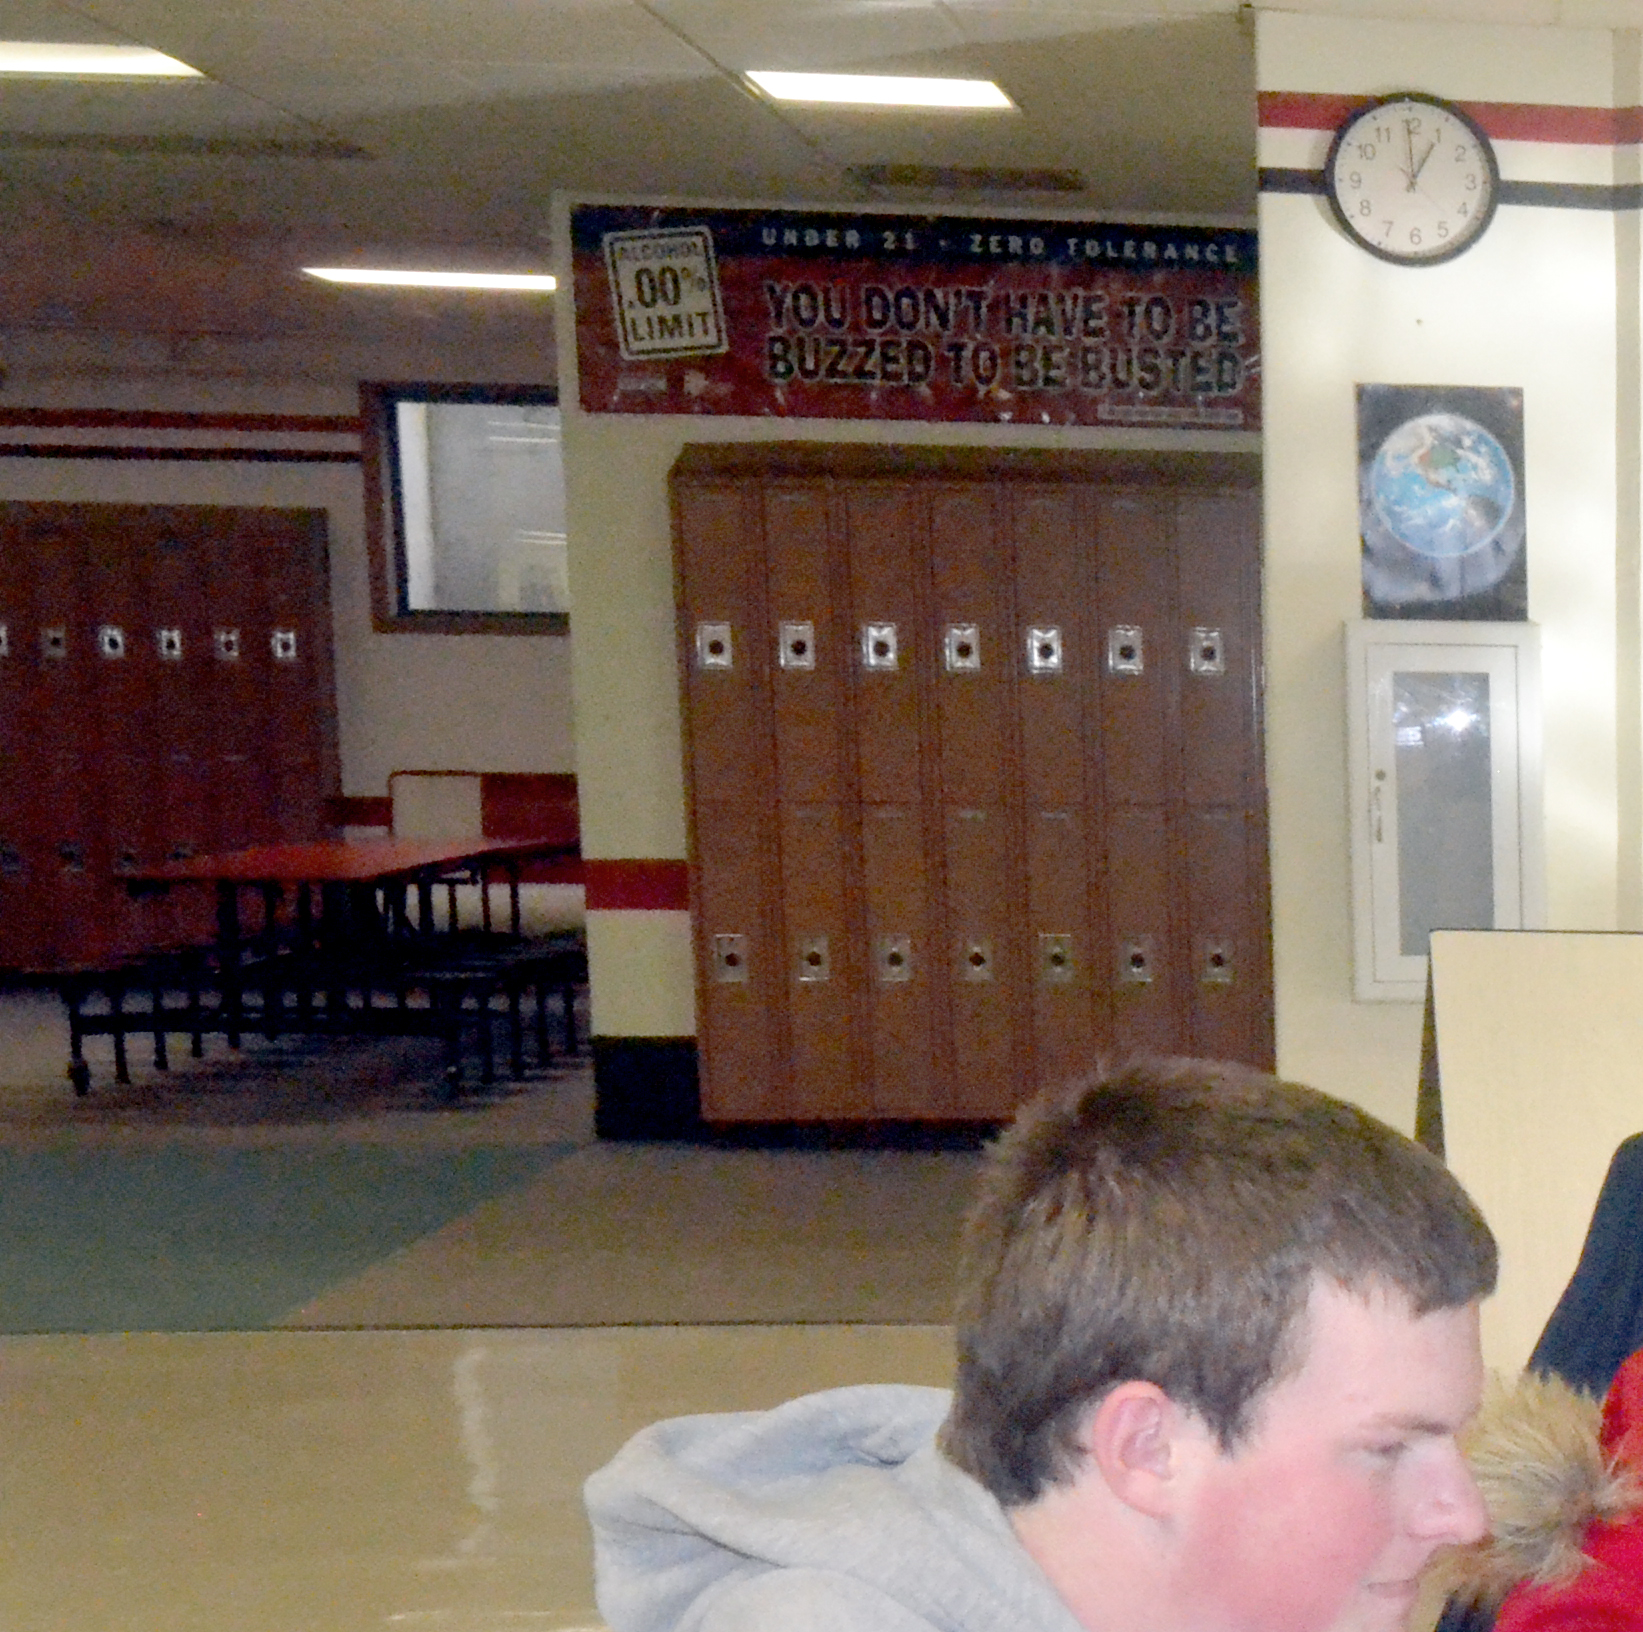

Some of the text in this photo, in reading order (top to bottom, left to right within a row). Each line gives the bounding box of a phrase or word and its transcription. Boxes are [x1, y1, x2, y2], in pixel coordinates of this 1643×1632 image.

[1374, 126, 1391, 143] 11
[1402, 117, 1422, 136] 12
[1434, 128, 1442, 144] 1
[1357, 142, 1376, 161] 10
[1454, 144, 1467, 162] 2
[1349, 171, 1362, 189] 9
[1465, 173, 1477, 191] 3
[1359, 199, 1372, 217] 8
[1457, 201, 1469, 218] 4
[1382, 220, 1394, 238] 7
[1409, 227, 1422, 246] 6
[1437, 221, 1449, 239] 5
[761, 226, 1239, 263] UNDER 21 ZERO TOLERANCE
[765, 281, 1244, 346] YOU DON'T HAVE TO BE
[629, 311, 710, 342] LIMIT
[766, 333, 935, 384] BUZZED
[943, 340, 1001, 388] TO
[1013, 344, 1069, 390] BE
[1079, 347, 1245, 396] BUSTED
